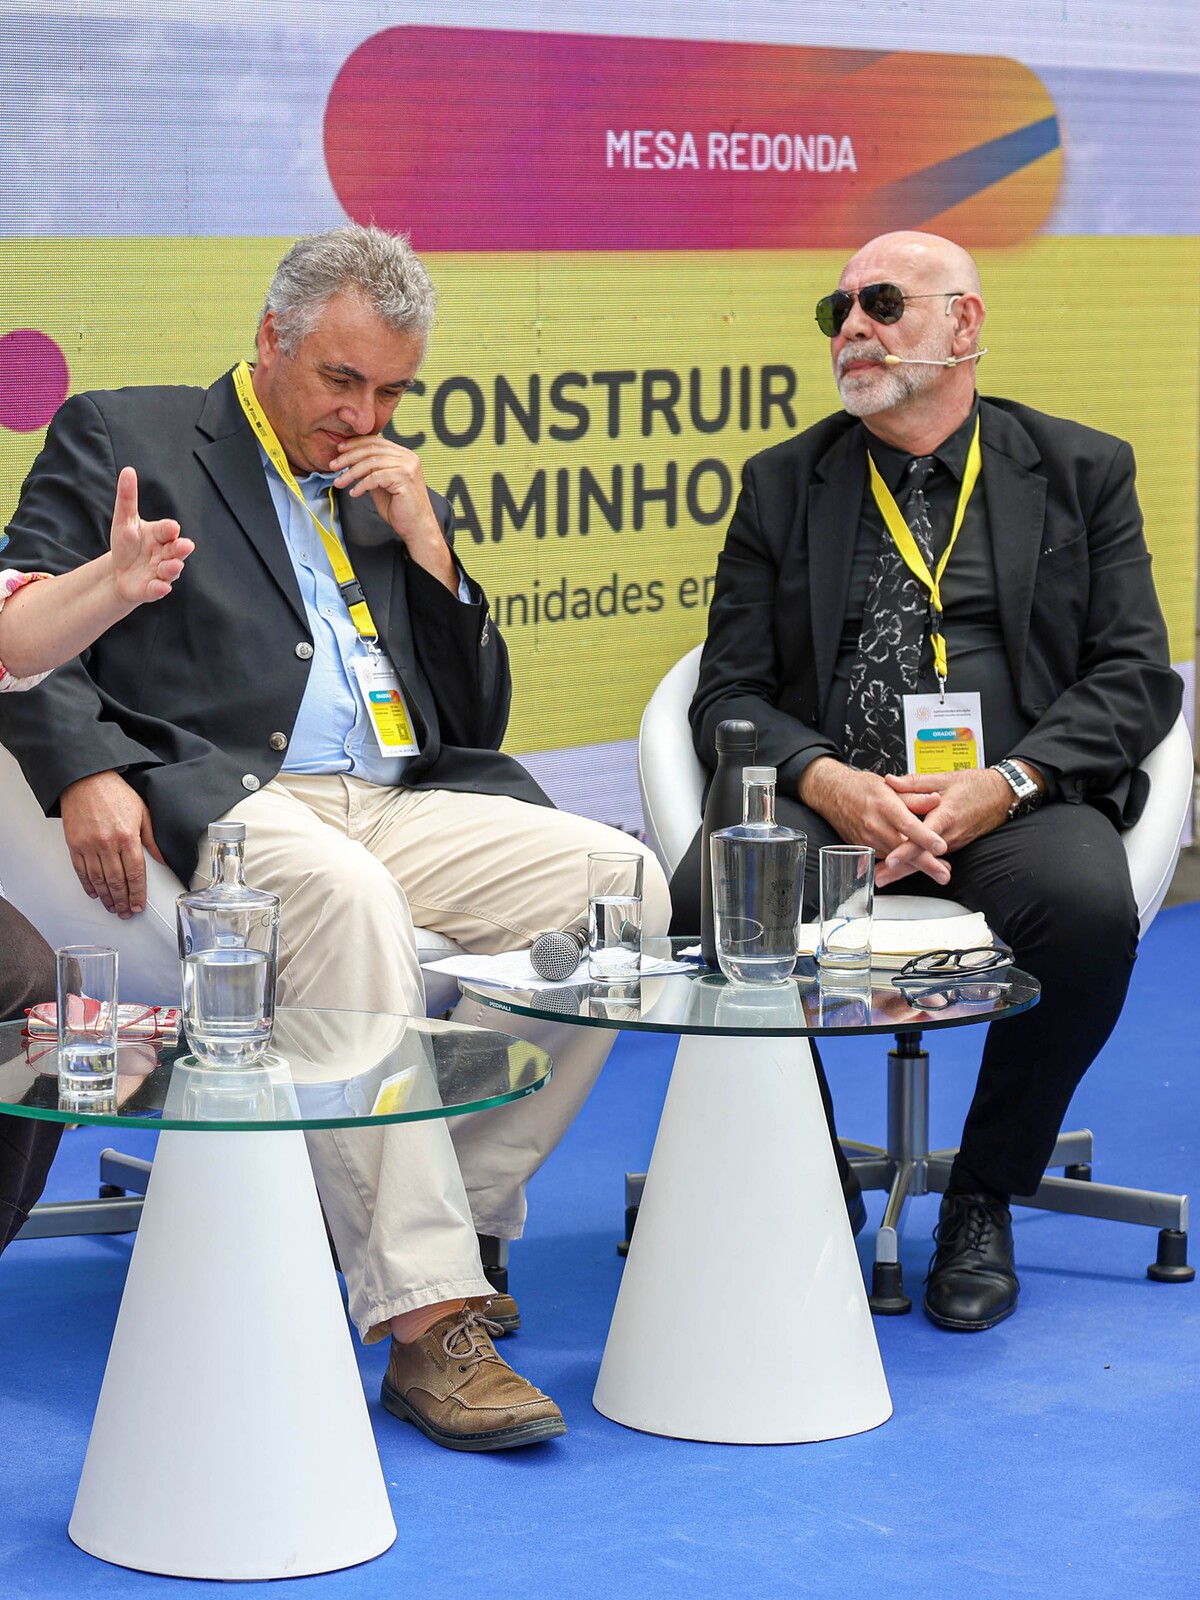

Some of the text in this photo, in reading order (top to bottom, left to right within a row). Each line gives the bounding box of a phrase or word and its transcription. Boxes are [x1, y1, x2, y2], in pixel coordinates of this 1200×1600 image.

[606, 129, 858, 173] MESA REDONDA
[384, 364, 798, 450] CONSTRUIR
[444, 458, 732, 544] AMINHO
[489, 1001, 510, 1010] PEDRALI
